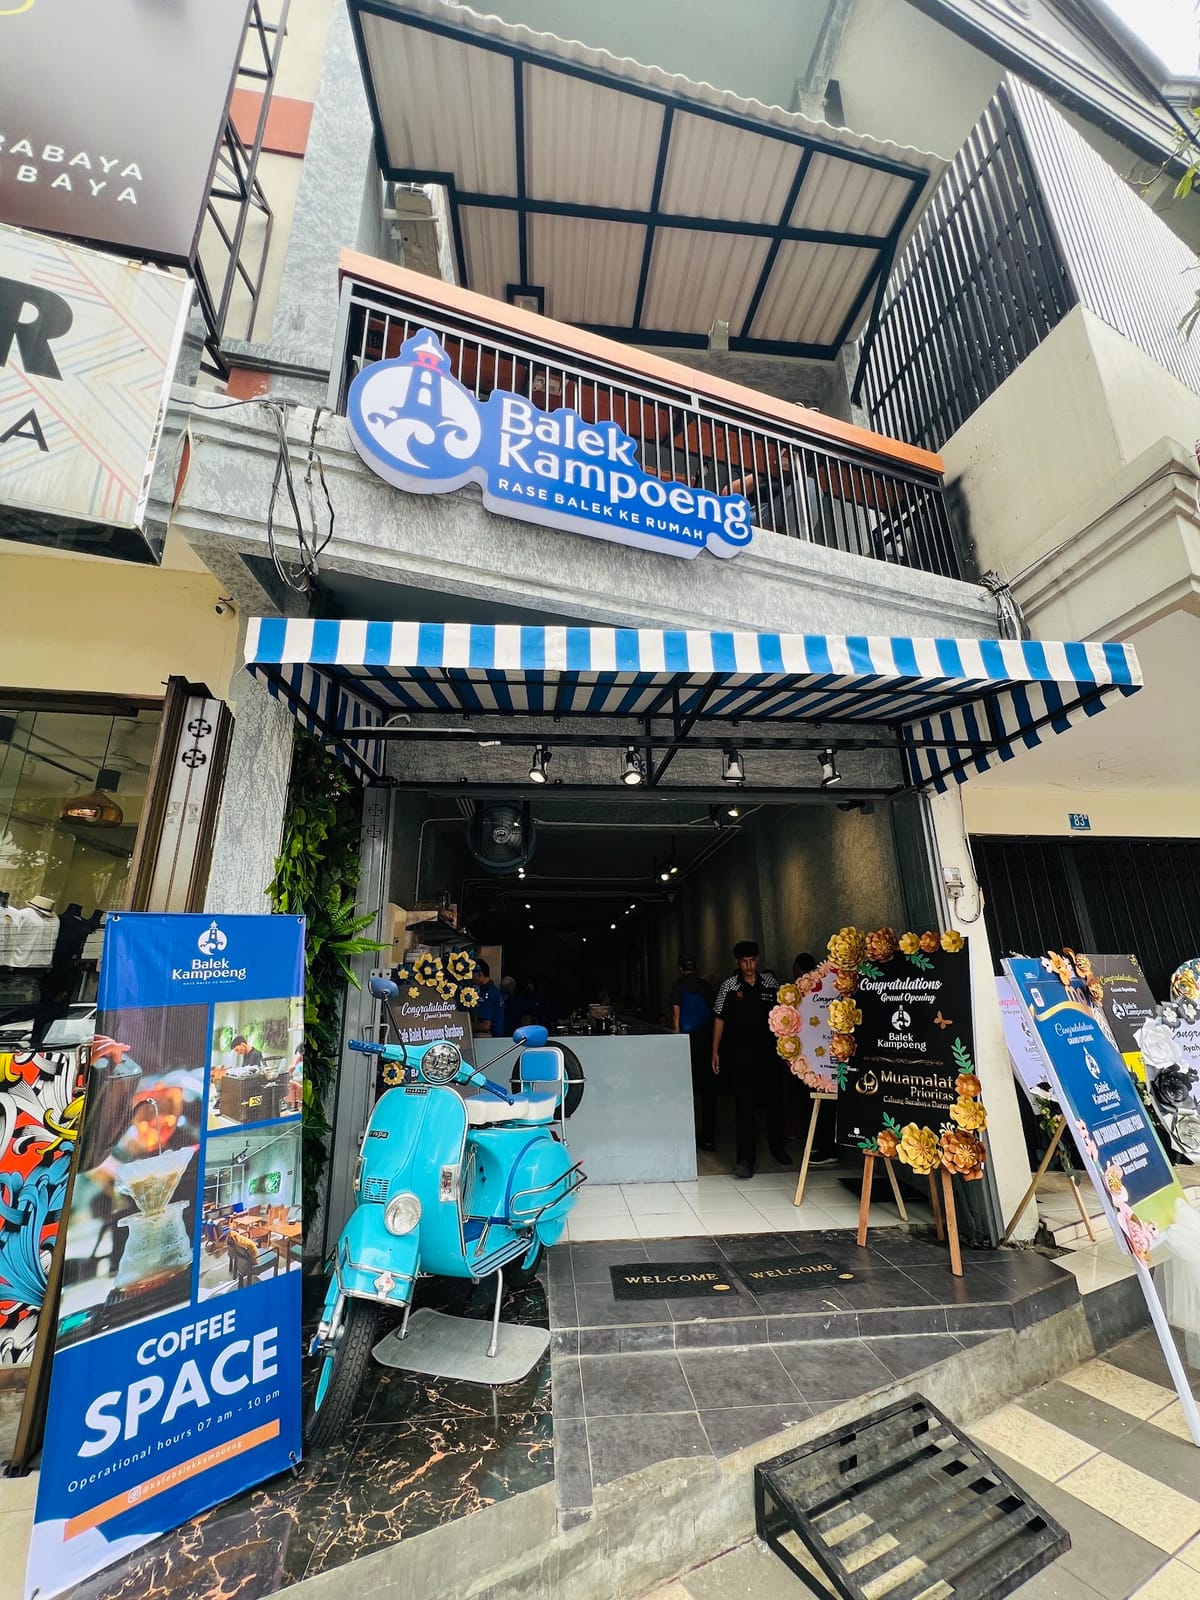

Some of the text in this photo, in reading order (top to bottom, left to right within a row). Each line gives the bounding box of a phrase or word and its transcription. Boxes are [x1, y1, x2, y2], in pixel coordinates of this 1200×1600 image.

[500, 397, 634, 467] Balek
[498, 432, 749, 540] Kampoeng
[498, 478, 703, 540] RASE BALEK KE RUMAH
[192, 957, 230, 970] Balek
[172, 967, 247, 981] Kampoeng
[860, 976, 943, 995] Congratulations
[880, 992, 936, 1004] Grand Opening
[401, 1001, 457, 1018] Congratulation
[888, 1032, 914, 1042] Balek
[877, 1039, 927, 1053] Kampoeng
[881, 1070, 954, 1090] Muamalat
[910, 1086, 954, 1102] Prioritas
[624, 1273, 719, 1285] WELCOME
[750, 1263, 838, 1280] WELCOME
[136, 1309, 236, 1366] COFFEE
[77, 1326, 278, 1458] SPACE
[67, 1445, 151, 1493] Operational
[157, 1426, 192, 1451] hours
[197, 1417, 212, 1432] 07
[217, 1410, 233, 1424] am
[247, 1396, 261, 1410] 10
[265, 1389, 280, 1404] pm
